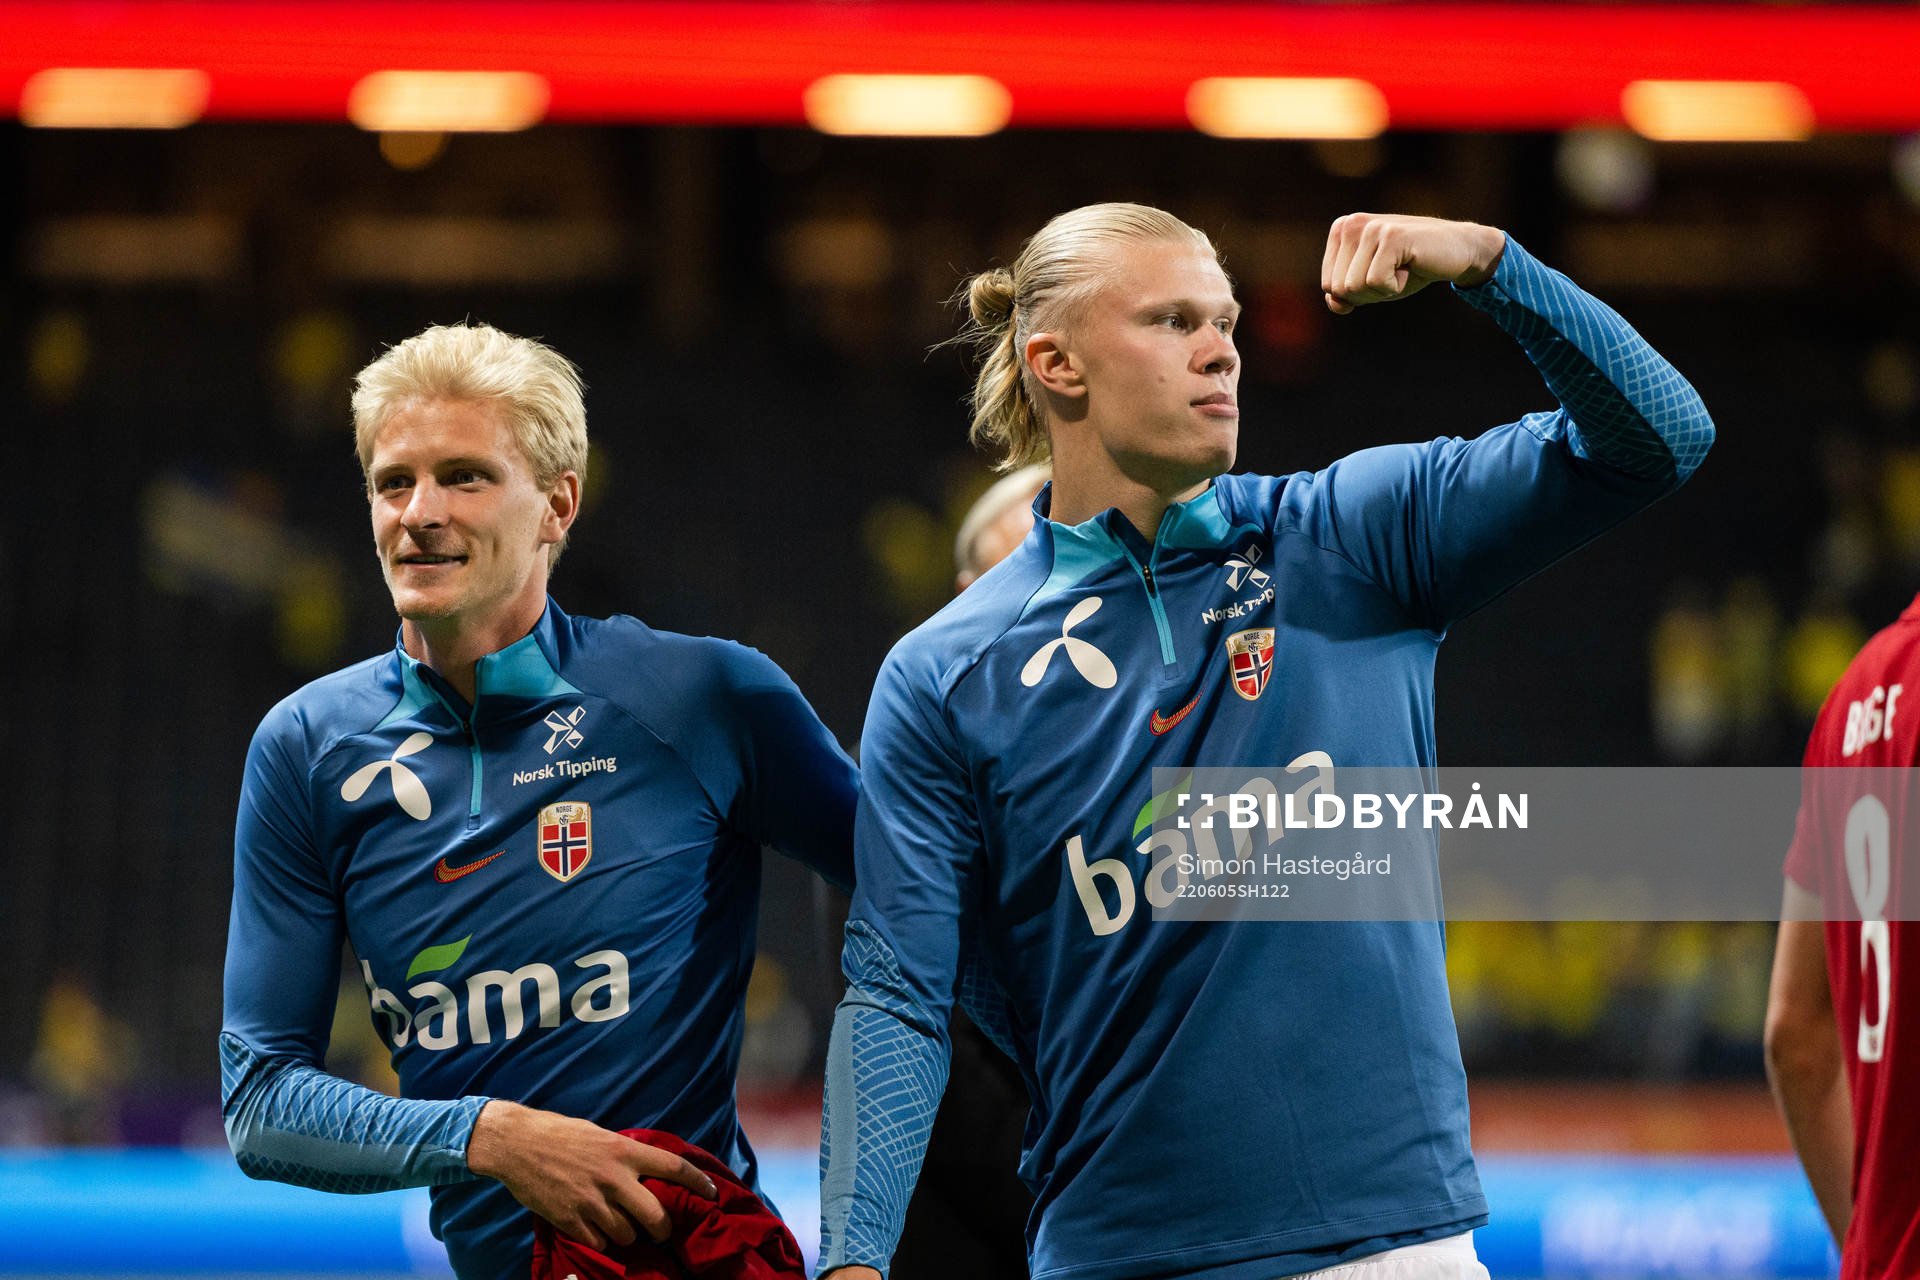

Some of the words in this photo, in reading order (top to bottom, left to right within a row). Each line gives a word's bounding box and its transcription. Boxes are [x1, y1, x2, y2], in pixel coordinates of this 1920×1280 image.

[1201, 602, 1246, 625] Norsk
[512, 763, 555, 786] Norsk
[555, 756, 617, 779] Tipping
[1065, 750, 1335, 936] bama
[360, 949, 630, 1050] bama
